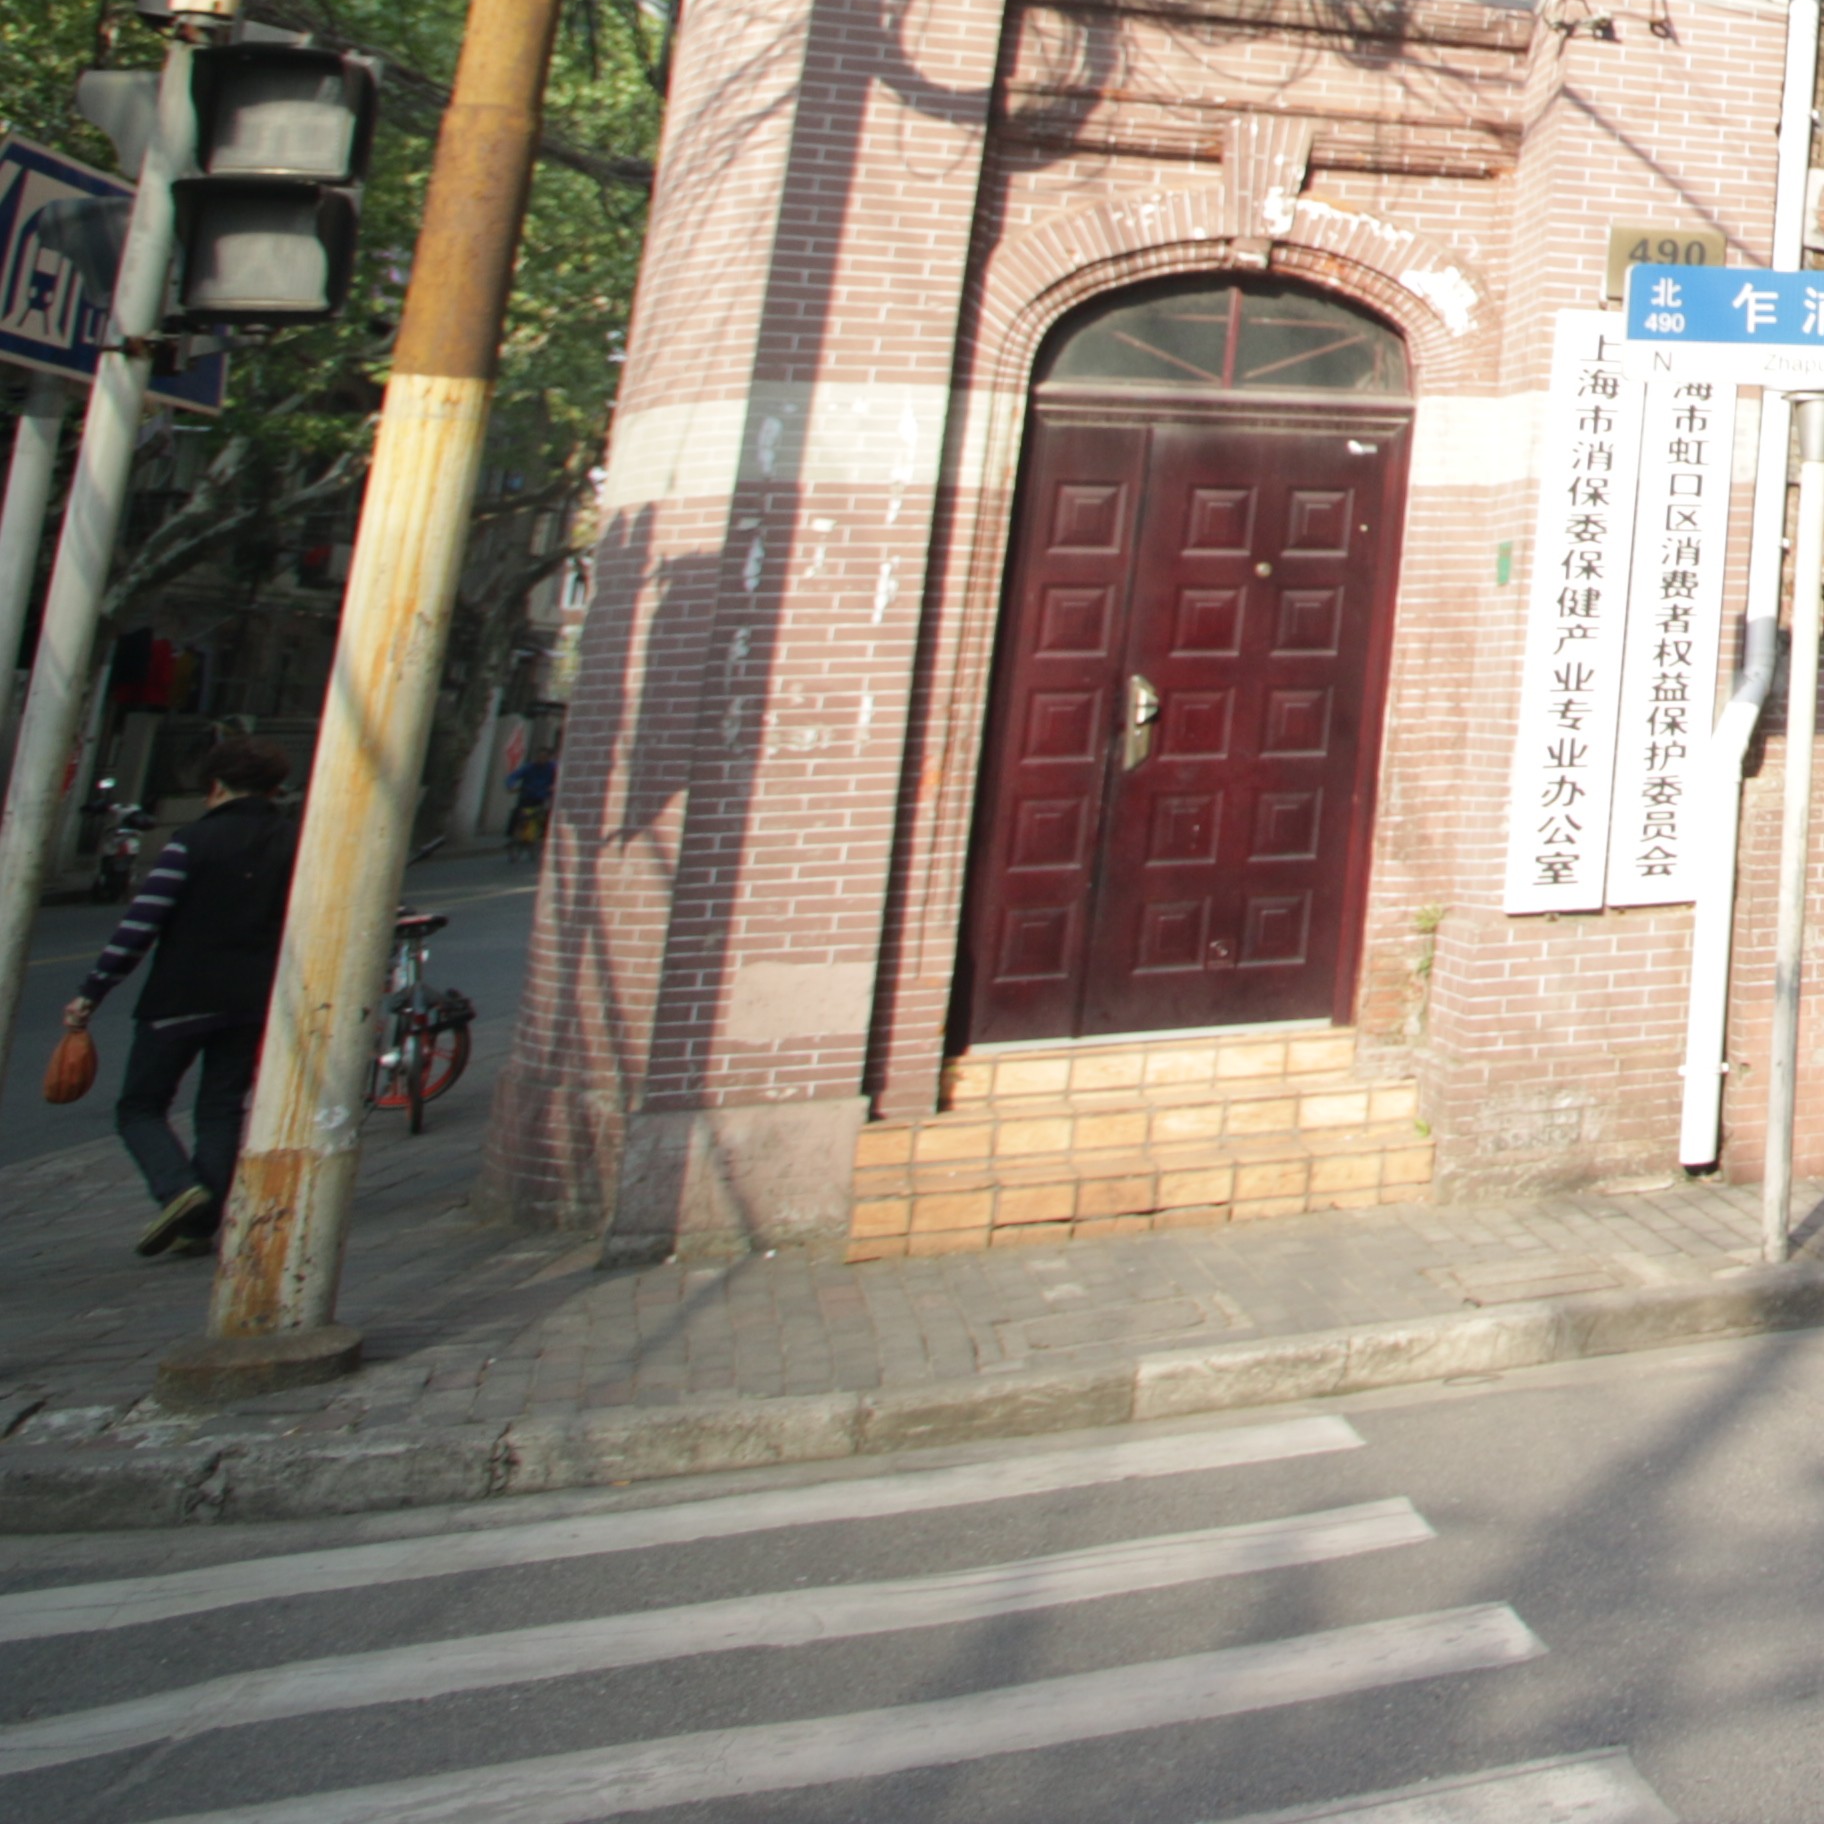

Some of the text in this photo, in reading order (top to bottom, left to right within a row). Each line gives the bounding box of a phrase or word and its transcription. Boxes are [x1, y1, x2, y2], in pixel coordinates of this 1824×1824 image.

[1628, 238, 1707, 266] 490
[1651, 277, 1682, 309] 北
[1644, 312, 1685, 333] 490
[1653, 351, 1672, 371] N
